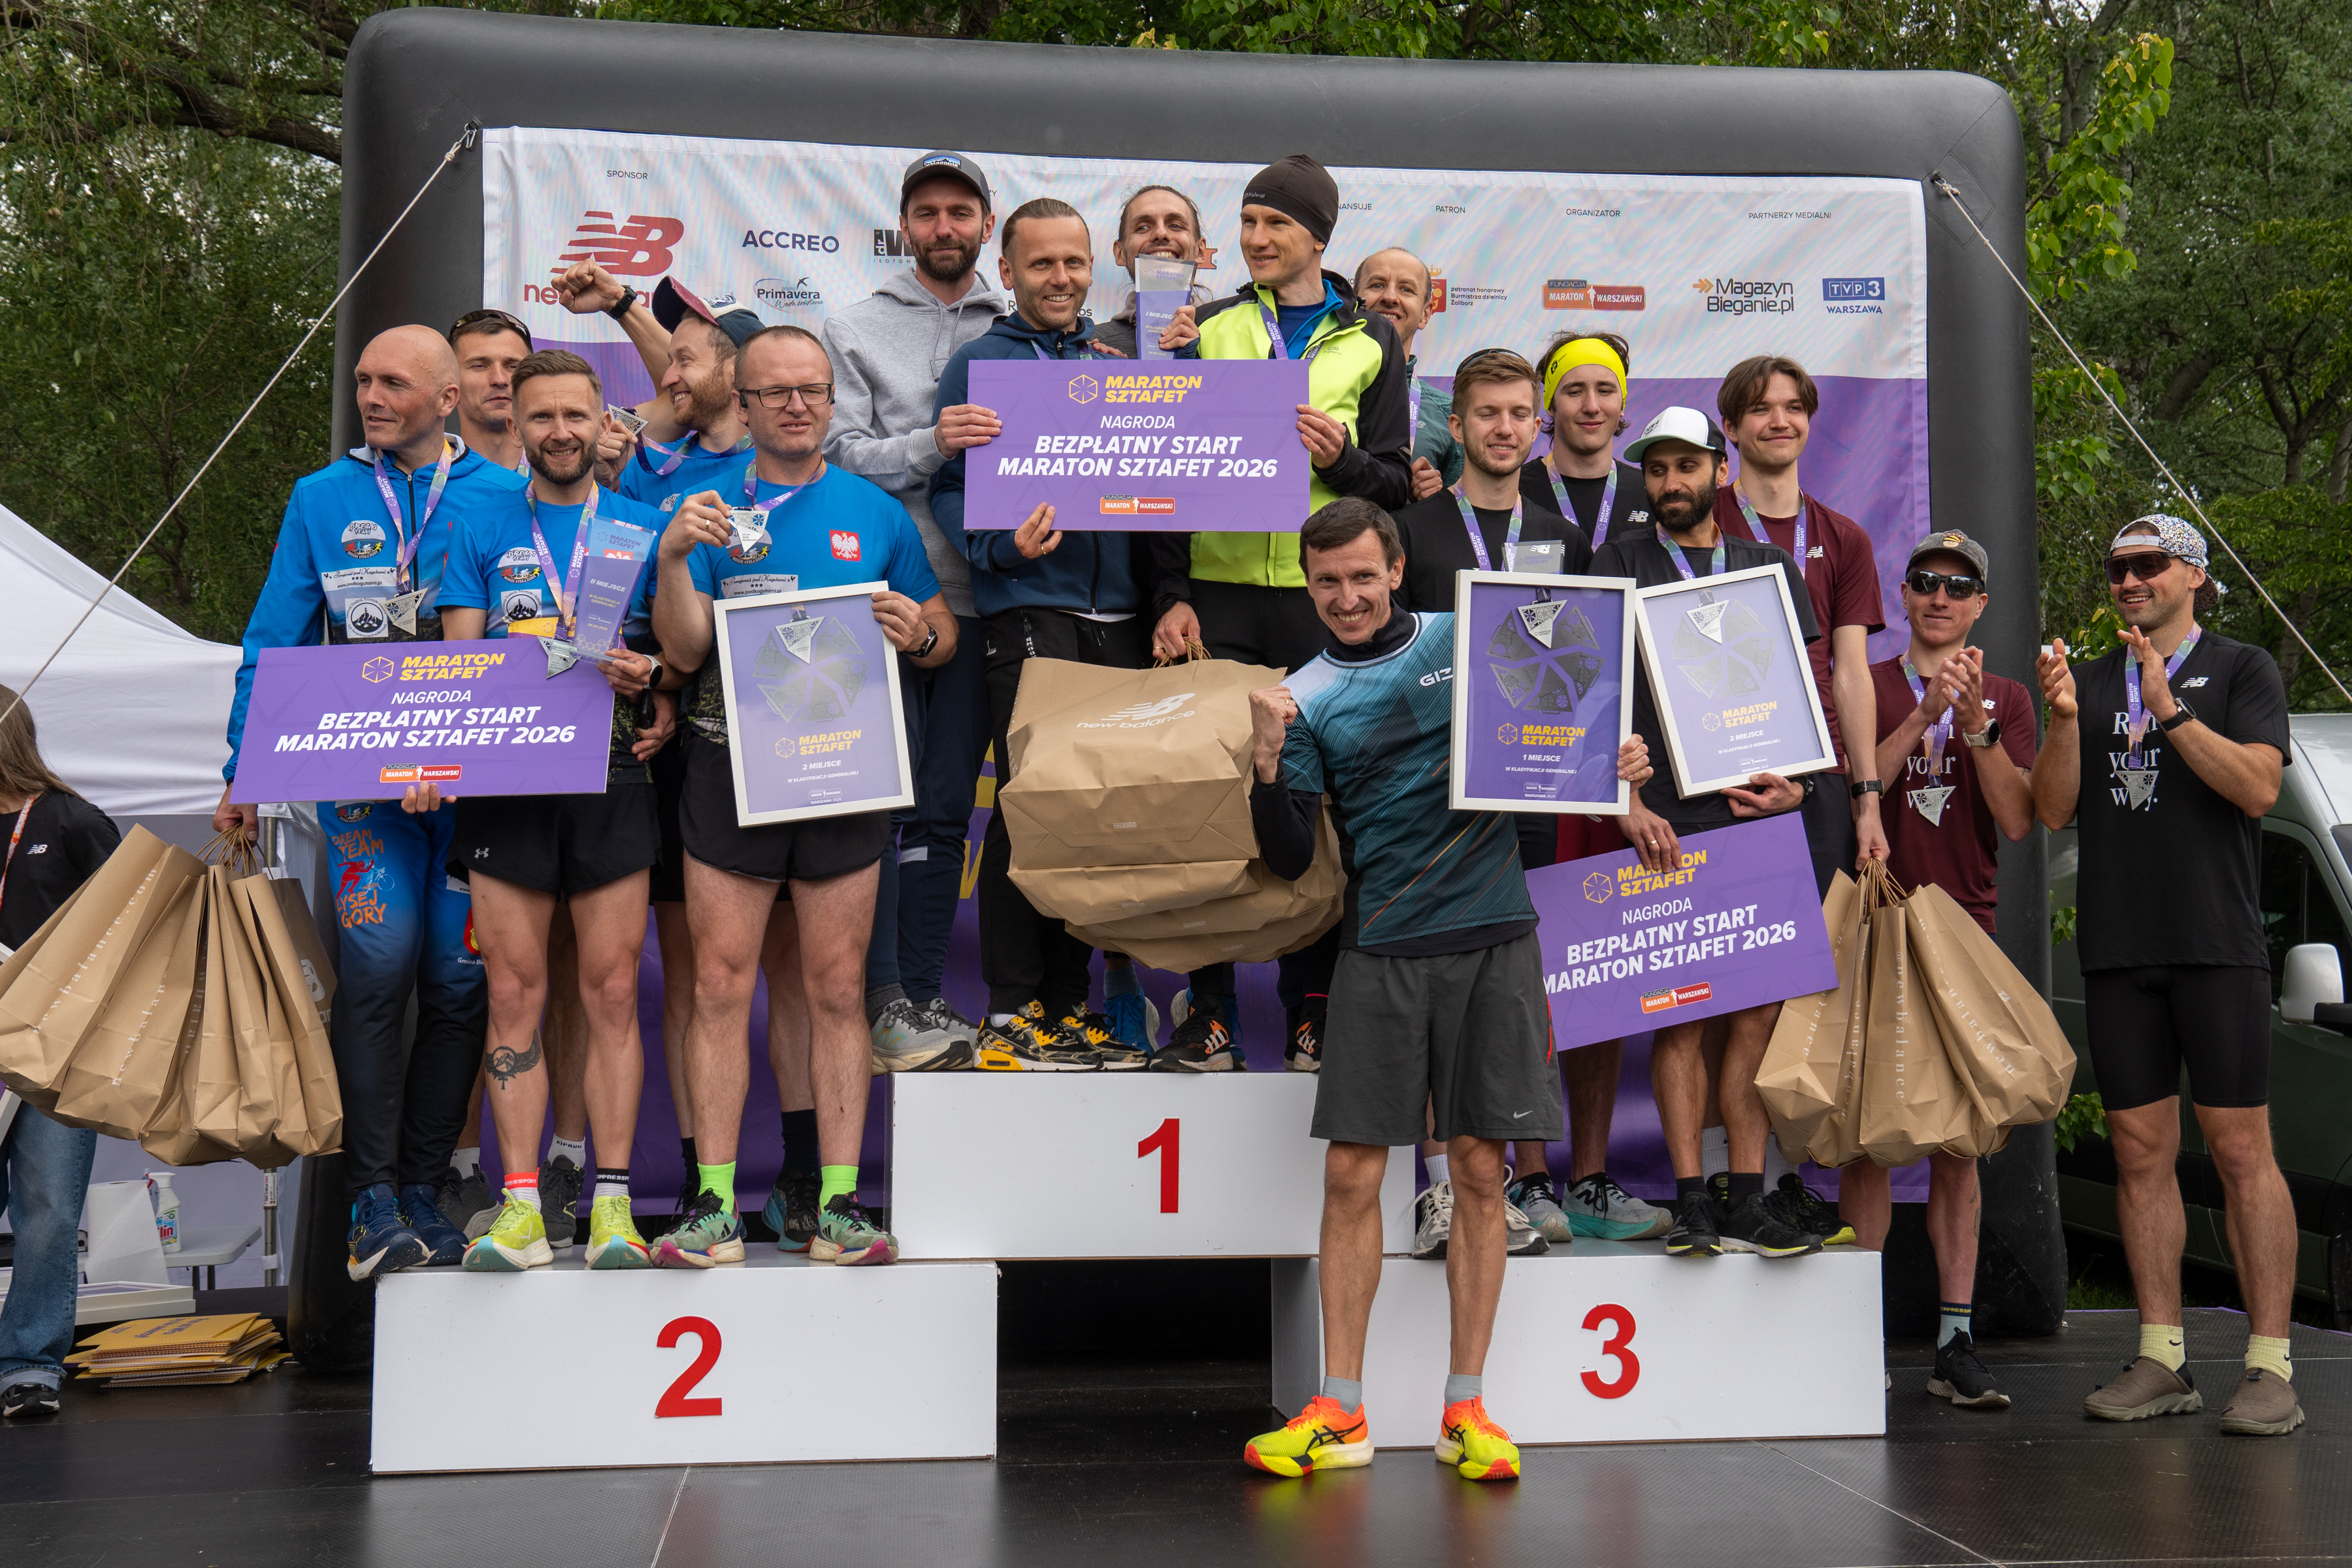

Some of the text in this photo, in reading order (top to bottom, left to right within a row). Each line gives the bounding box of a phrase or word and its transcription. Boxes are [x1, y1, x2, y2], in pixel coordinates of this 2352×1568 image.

[607, 170, 648, 180] SPONSOR
[1435, 205, 1465, 214] PATRON
[1566, 208, 1620, 217] ORGANIZATOR
[742, 230, 840, 253] ACCREO
[757, 289, 821, 300] Primavera
[1716, 278, 1793, 298] Magazyn
[1549, 293, 1642, 302] MARATON WARSZAWSKI
[1707, 296, 1794, 316] Bieganie.pl
[1827, 305, 1882, 314] WARSZAWA
[1105, 376, 1202, 389] MARATON
[1105, 390, 1188, 404] SZTAFET
[1100, 415, 1176, 429] NAGRODA
[1034, 436, 1243, 454] BEZPŁATNY START
[997, 458, 1277, 478] MARATON SZTAFET 2026
[376, 476, 390, 498] MARATON
[382, 478, 394, 498] SZTAFET
[1599, 500, 1609, 523] MARATON
[349, 523, 378, 532] DREAM
[532, 532, 544, 556] MARATON
[538, 533, 548, 555] SZTAFET
[608, 539, 636, 550] SZTAFET
[609, 534, 642, 547] MARATON
[1470, 532, 1481, 556] MARATON
[1476, 535, 1486, 556] SZTAFET
[508, 550, 537, 559] DREAM
[572, 542, 581, 568] MARATON
[577, 546, 585, 568] SZTAFET
[595, 580, 627, 593] MIEJSCE
[401, 653, 506, 669] MARATON
[399, 666, 488, 681] SZTAFET
[391, 689, 471, 705] NAGRODA
[318, 706, 541, 731] BEZPŁATNY START
[1723, 700, 1777, 719] MARATON
[1119, 710, 1196, 728] balance
[1725, 711, 1771, 728] SZTAFET
[2112, 711, 2159, 734] Rn
[274, 725, 576, 753] MARATON SZTAFET 2026
[798, 729, 862, 745] MARATON
[1522, 725, 1586, 737] MARATON
[1735, 730, 1764, 741] MIEJSCE
[800, 740, 853, 755] SZTAFET
[1522, 735, 1576, 747] SZTAFET
[1723, 744, 1753, 753] KLASYFIKACJI
[1752, 738, 1781, 747] GENERALNEJ
[809, 760, 841, 770] MIEJSCE
[385, 770, 459, 779] MARATON WARSZAWSKI
[793, 774, 827, 783] KLASYFIKACJI
[332, 828, 372, 846] DREAM
[338, 838, 384, 862] TEAM
[1620, 868, 1695, 897] SZTAFET
[1622, 898, 1693, 925] NAGRODA
[1567, 904, 1757, 966] BEZPŁATNY START
[1543, 920, 1797, 996] MARATON SZTAFET 2026
[1643, 988, 1670, 998] FUNDACJA
[1646, 987, 1710, 1007] MARATON WARSZAWSKI
[1895, 951, 1909, 1099] @newbalance
[556, 1140, 582, 1149] KIPRUN
[1138, 1118, 1180, 1213] 1
[1580, 1303, 1641, 1399] 3
[654, 1316, 723, 1418] 2
